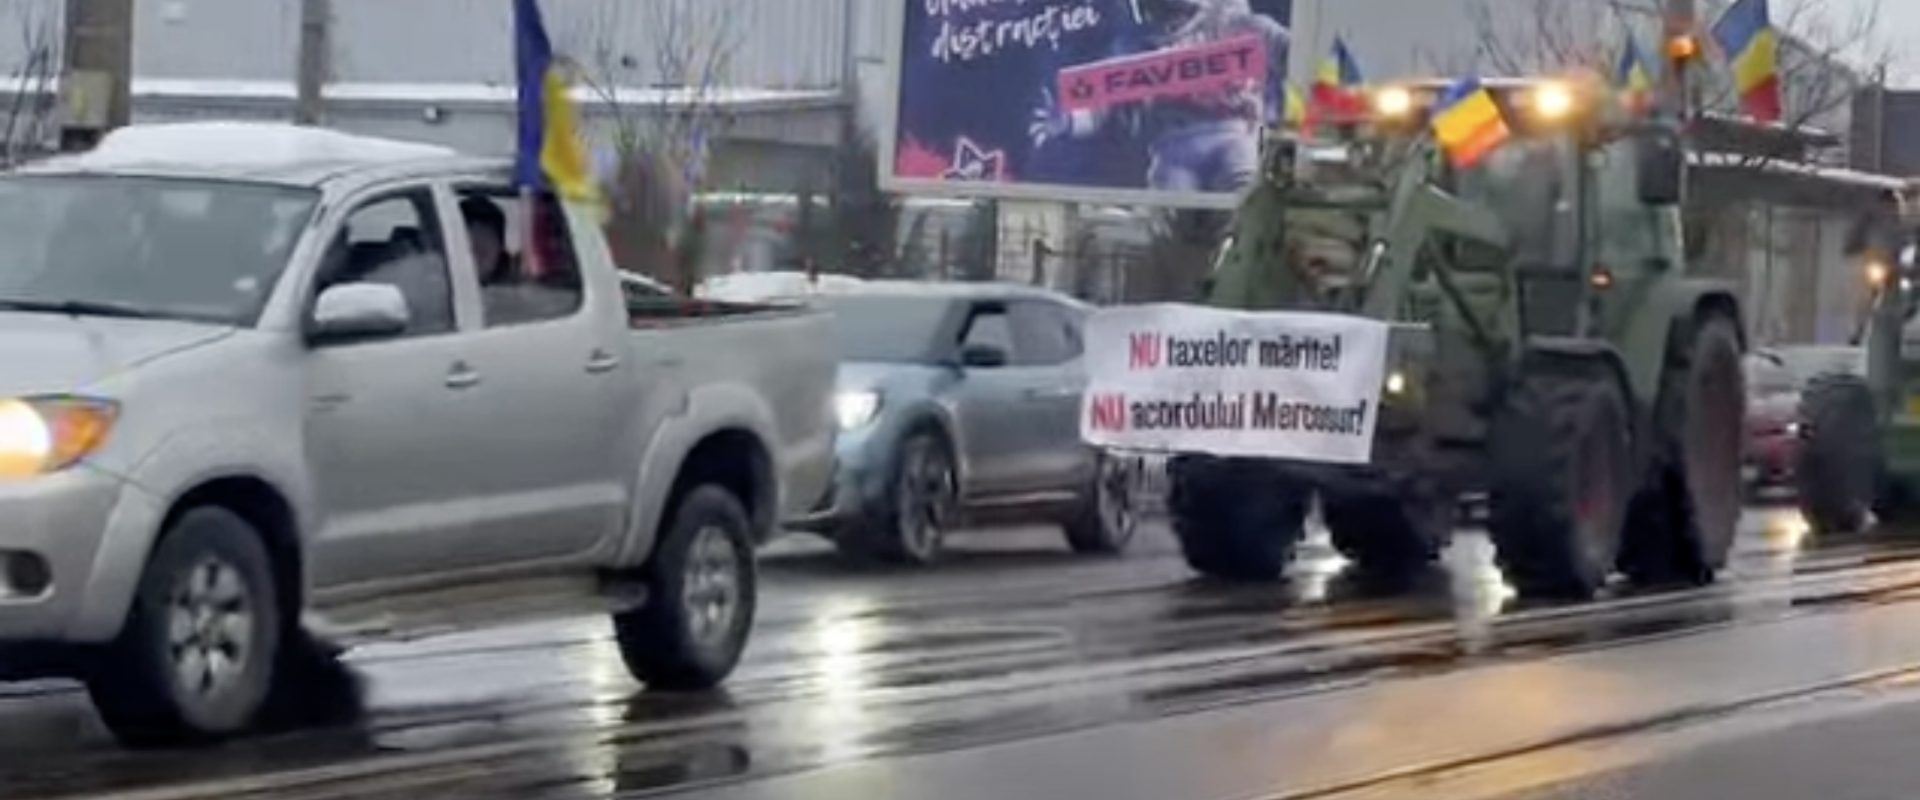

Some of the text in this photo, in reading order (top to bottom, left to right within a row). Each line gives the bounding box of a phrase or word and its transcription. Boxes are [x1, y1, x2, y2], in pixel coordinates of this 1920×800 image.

[1104, 47, 1255, 94] FAVBET
[1129, 332, 1162, 369] NU
[1167, 330, 1252, 368] taxelor
[1091, 392, 1367, 435] NU acordului Mercosur!
